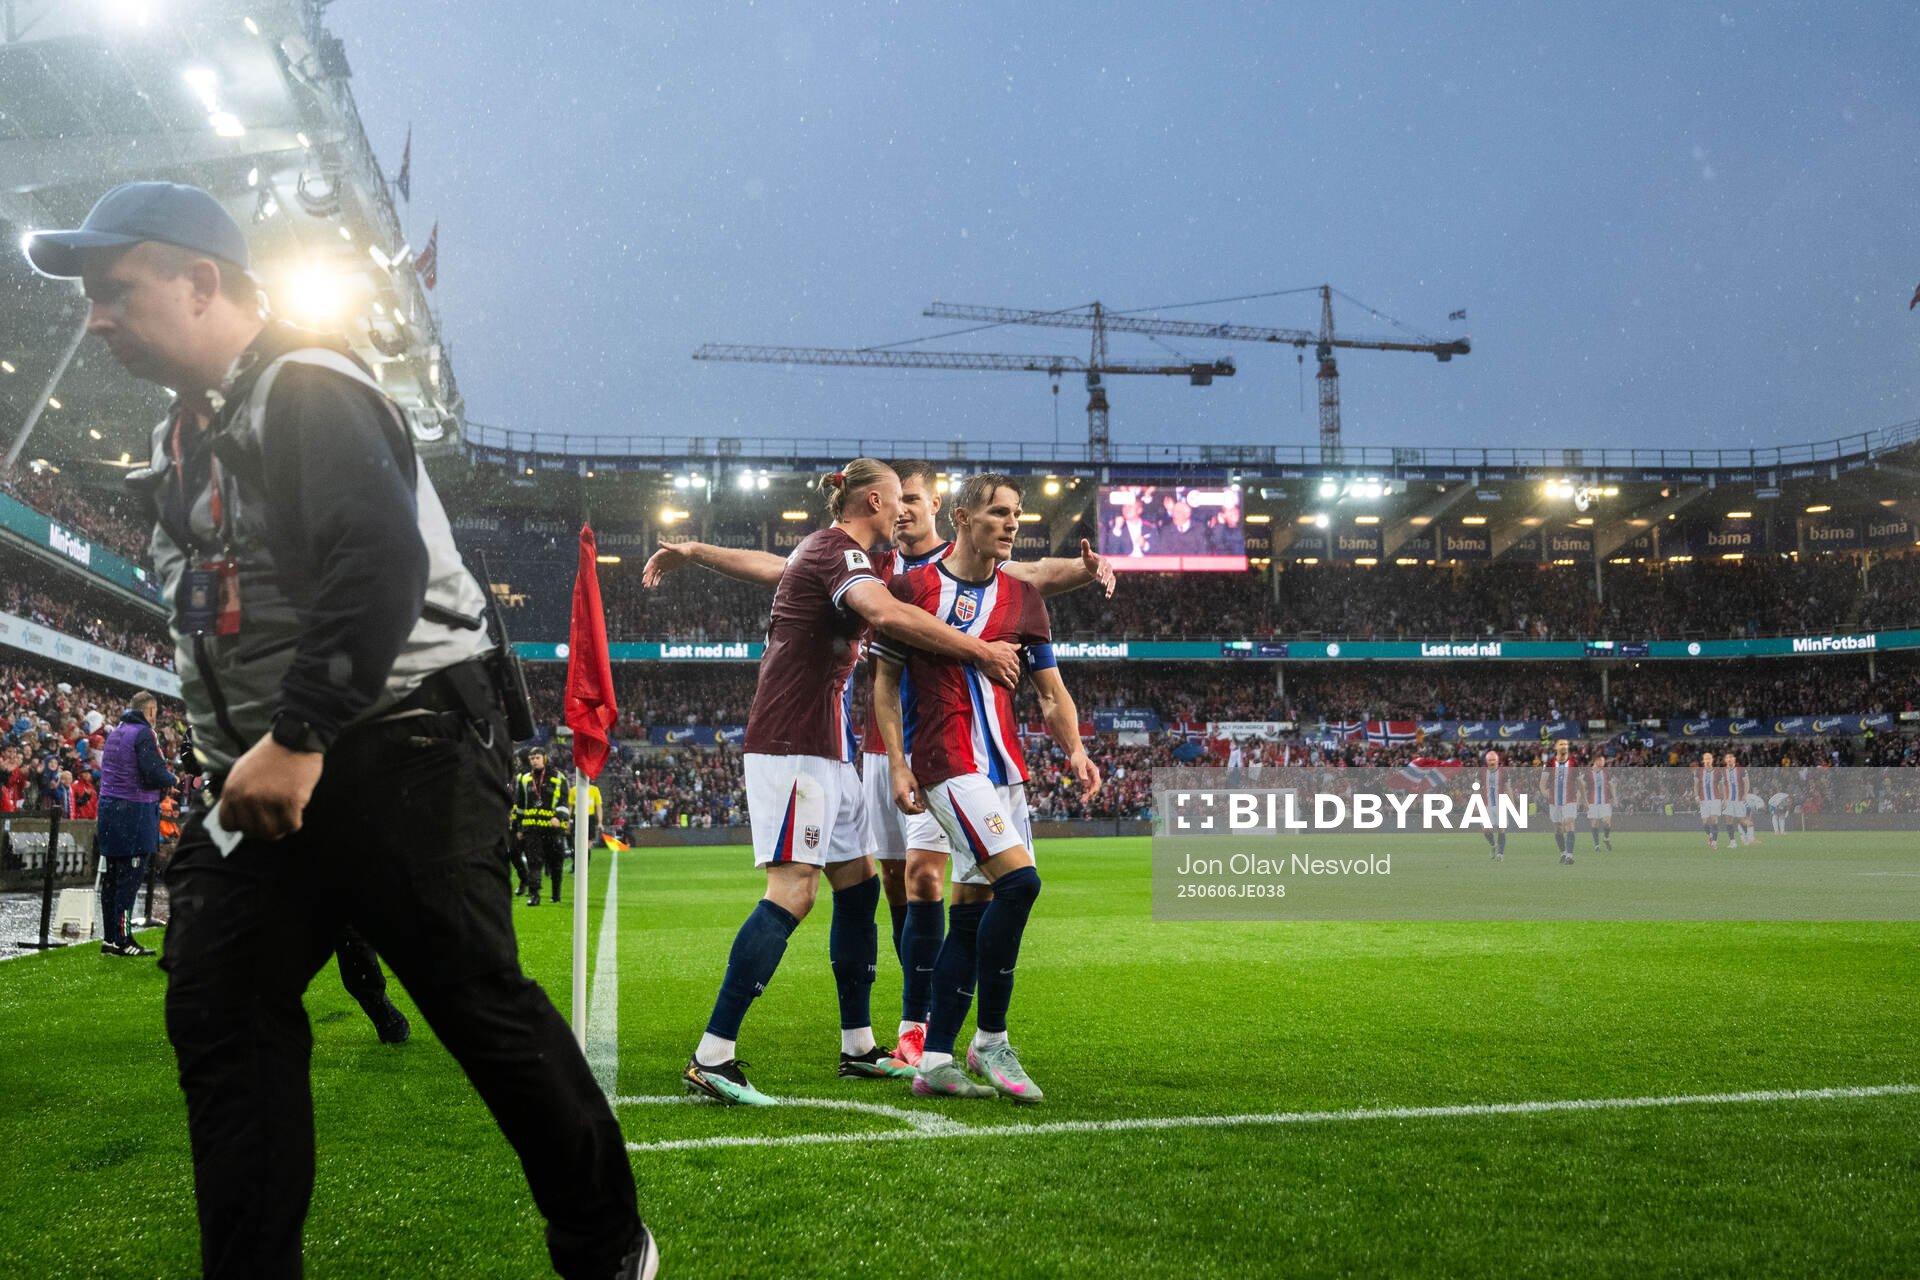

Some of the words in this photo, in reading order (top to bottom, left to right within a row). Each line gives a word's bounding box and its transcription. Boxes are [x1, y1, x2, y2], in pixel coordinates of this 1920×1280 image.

[1810, 526, 1854, 540] bama
[1868, 522, 1908, 536] bama
[50, 523, 90, 566] MinFotball
[1339, 536, 1376, 549] bama
[1448, 536, 1486, 550] bama
[1552, 536, 1590, 550] bama
[1708, 531, 1750, 546] bama
[660, 643, 692, 658] Last
[694, 644, 722, 658] ned
[724, 642, 748, 658] nå!
[1052, 643, 1128, 656] MinFotball
[1422, 642, 1451, 656] Last
[1452, 642, 1478, 656] ned
[1480, 642, 1502, 656] nå!
[1793, 634, 1876, 652] MinFotball
[1112, 718, 1144, 728] bama
